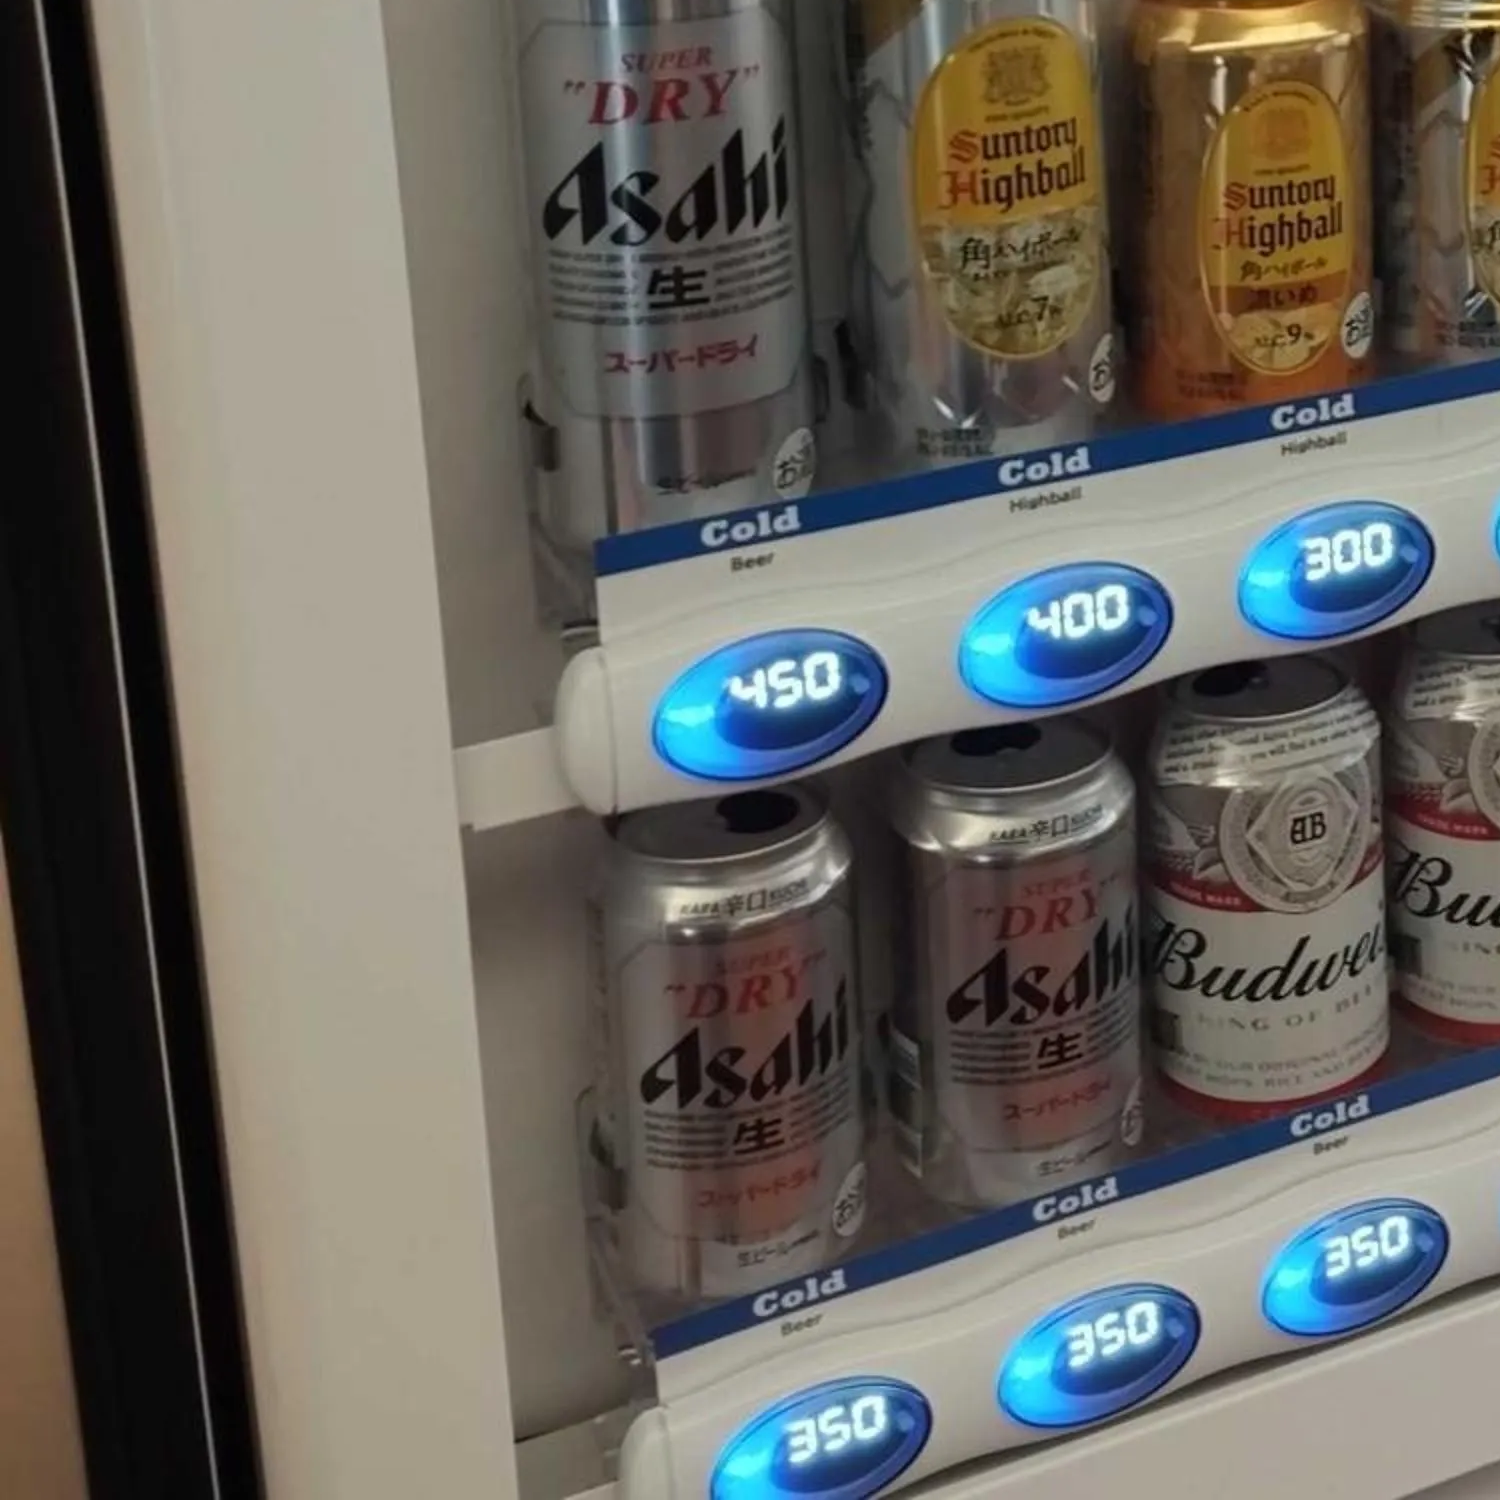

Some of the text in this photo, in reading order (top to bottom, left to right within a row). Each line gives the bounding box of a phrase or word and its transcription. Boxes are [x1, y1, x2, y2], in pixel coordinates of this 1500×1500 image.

[621, 47, 714, 73] SUPER
[948, 117, 1077, 164] Suntory
[542, 113, 789, 246] Asahi
[939, 146, 1086, 214] Highball
[1223, 174, 1335, 211] Suntory
[1212, 201, 1343, 257] Highball
[646, 265, 710, 310] 生
[604, 333, 759, 375] スーパードライ
[1271, 394, 1355, 431] Cold
[999, 445, 1091, 485] Cold
[1281, 431, 1348, 457] Highball
[1009, 487, 1083, 514] Highball
[701, 505, 801, 548] Cold
[730, 551, 775, 572] Beer
[1304, 521, 1393, 582] 300
[1027, 583, 1130, 639] 400
[728, 650, 842, 709] 450
[1029, 814, 1070, 840] 辛口
[724, 887, 767, 916] 辛口
[1020, 869, 1093, 896] SUPER
[945, 904, 1136, 1026] Asahi
[640, 974, 848, 1108] Asahi
[1036, 1033, 1084, 1070] 生
[732, 1118, 786, 1155] 生
[1290, 1094, 1371, 1138] Cold
[1312, 1134, 1348, 1156] Beer
[1032, 1177, 1119, 1223] Cold
[1057, 1218, 1096, 1240] Beer
[1325, 1215, 1409, 1278] 350
[752, 1269, 846, 1317] Cold
[780, 1313, 823, 1337] Beer
[1065, 1301, 1160, 1370] 350
[785, 1394, 888, 1464] 350
